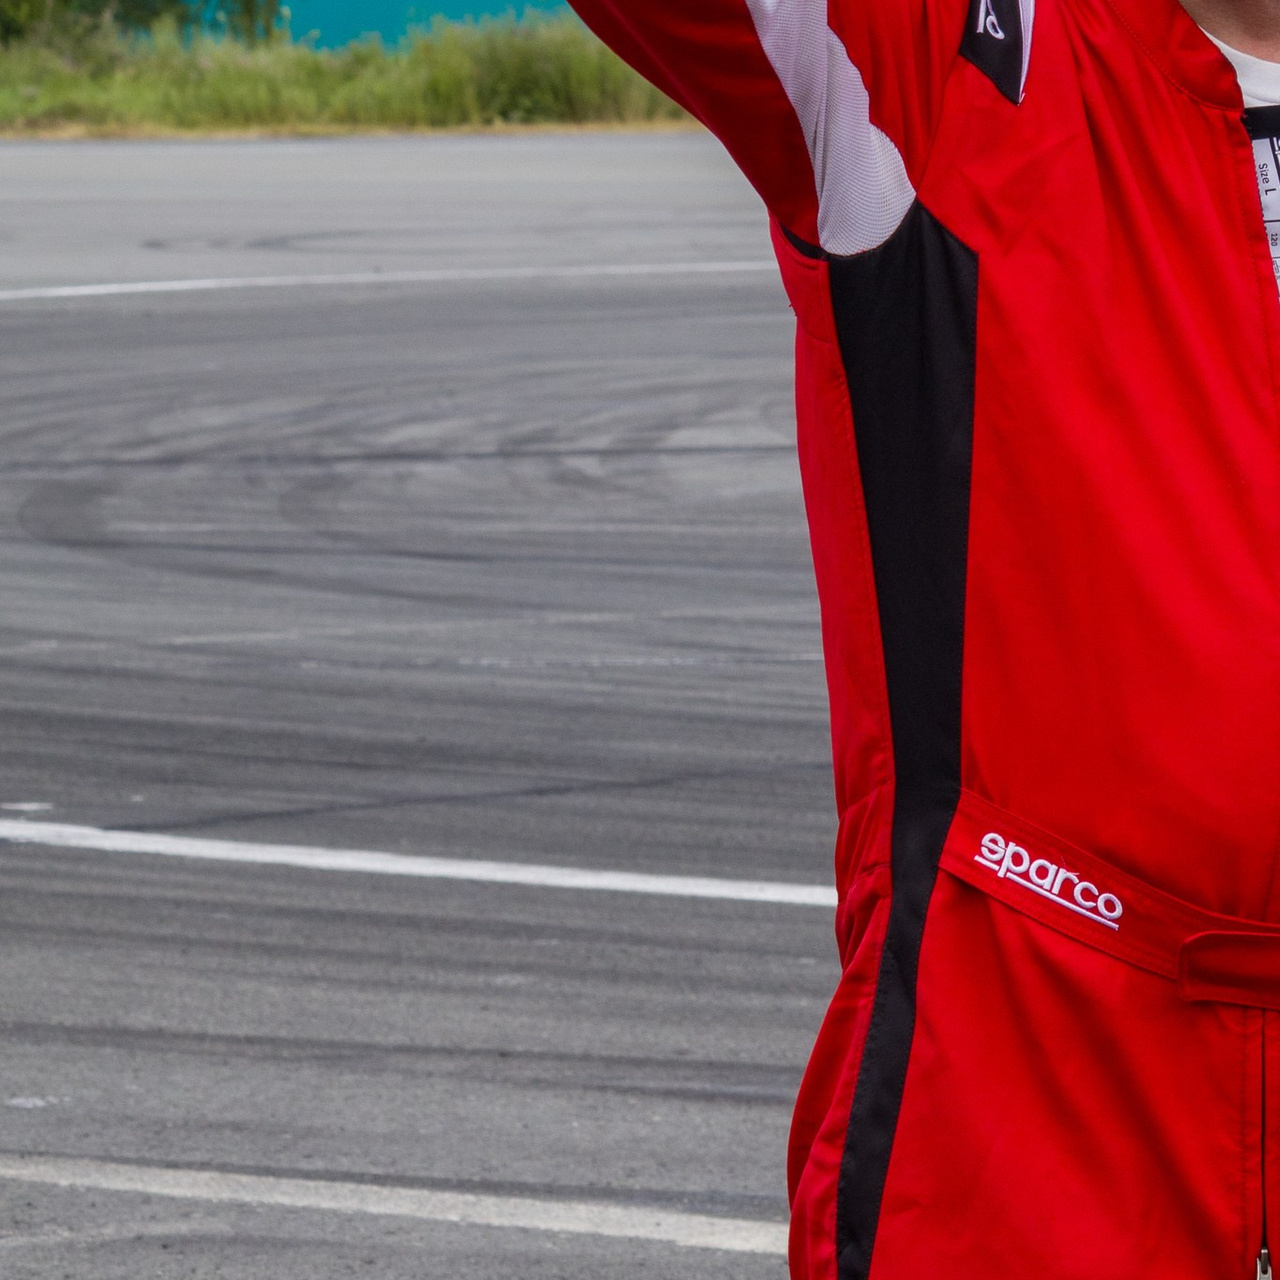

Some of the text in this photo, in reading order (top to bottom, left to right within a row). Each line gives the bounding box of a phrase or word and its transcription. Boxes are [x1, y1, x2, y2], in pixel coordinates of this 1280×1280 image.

[1258, 163, 1277, 196] Size L
[980, 832, 1123, 920] sparco
